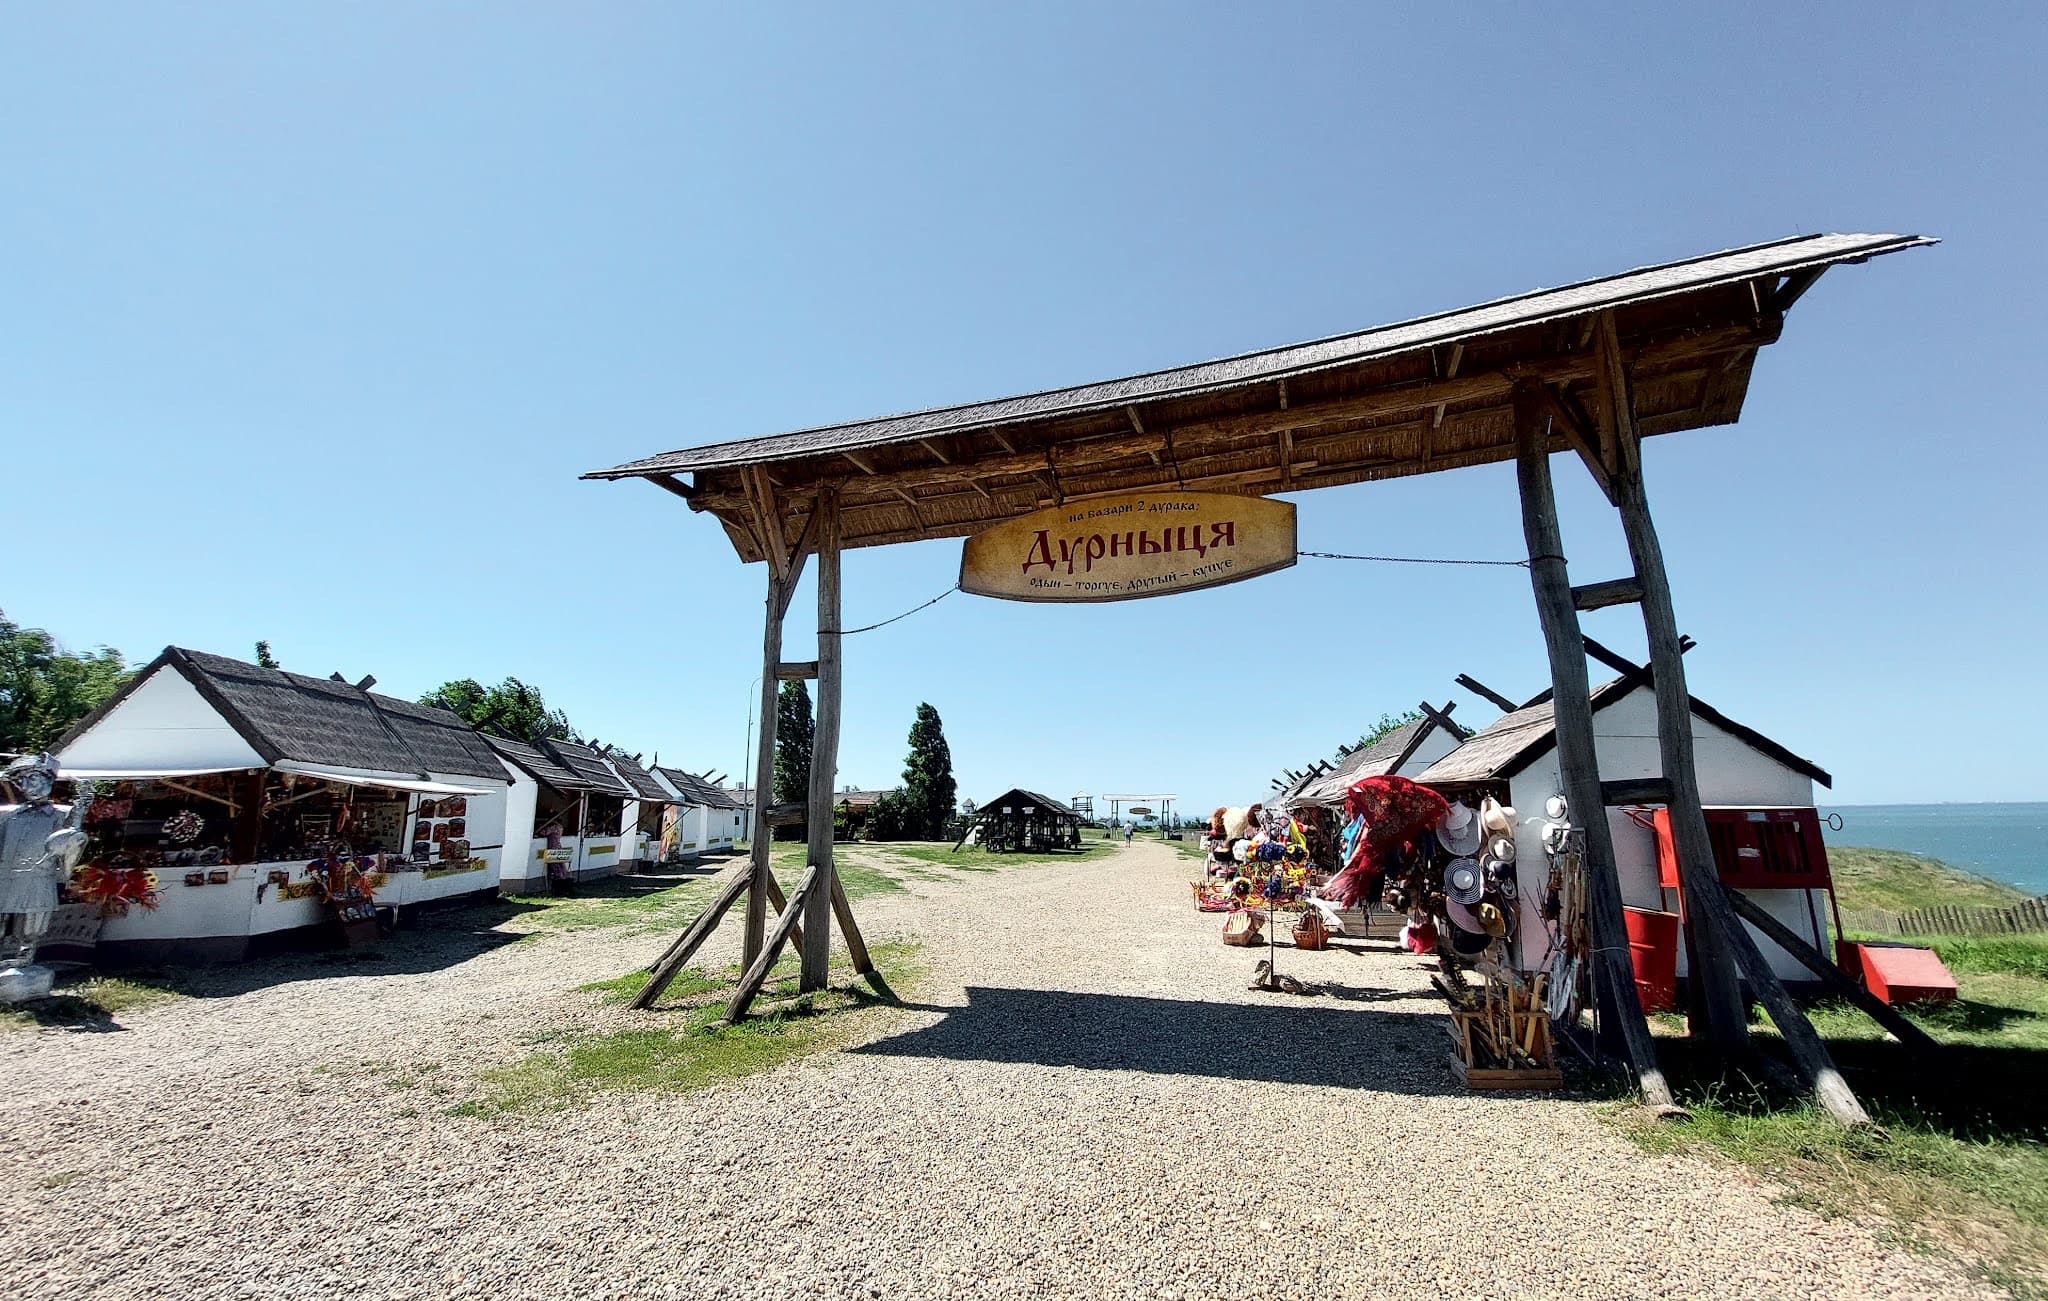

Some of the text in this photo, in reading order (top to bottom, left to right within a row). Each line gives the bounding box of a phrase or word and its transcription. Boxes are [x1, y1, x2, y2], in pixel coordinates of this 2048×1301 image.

[1069, 513, 1084, 523] на
[1137, 501, 1145, 512] 2
[1022, 521, 1235, 575] Дурныця
[1029, 577, 1061, 589] одын
